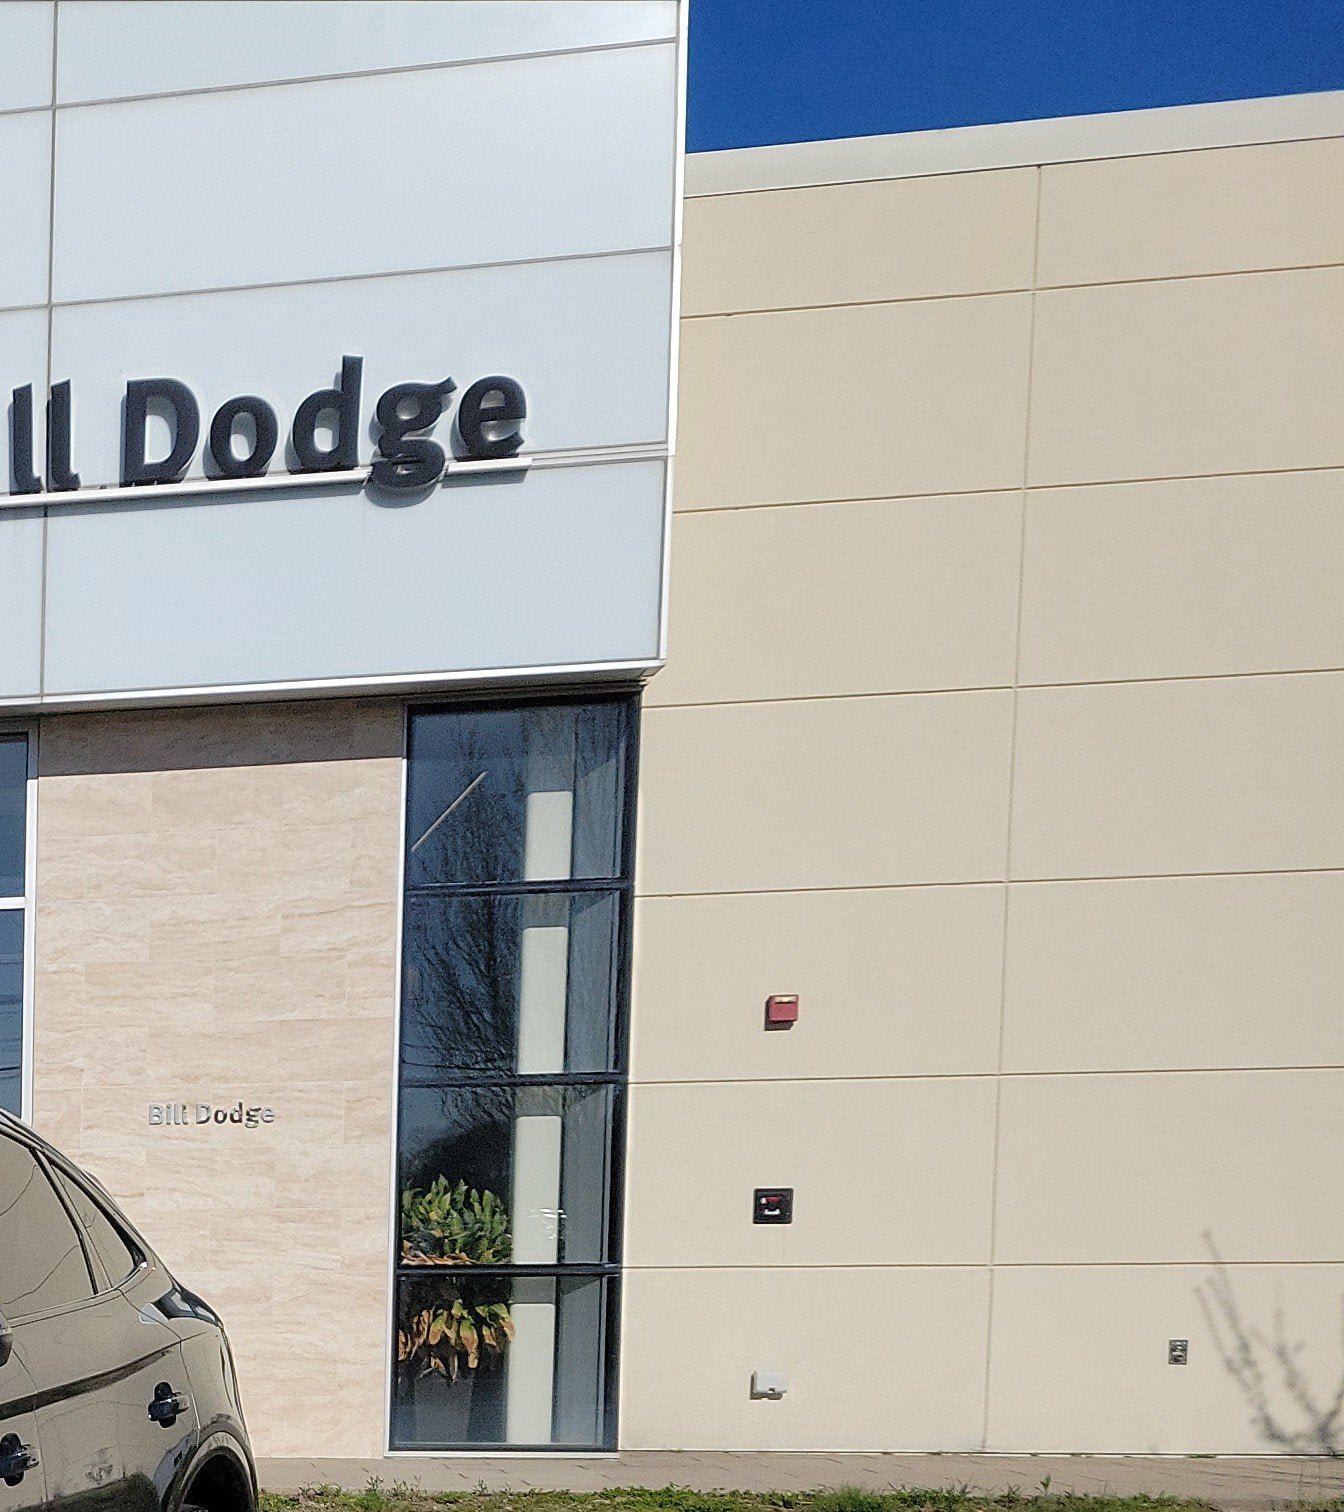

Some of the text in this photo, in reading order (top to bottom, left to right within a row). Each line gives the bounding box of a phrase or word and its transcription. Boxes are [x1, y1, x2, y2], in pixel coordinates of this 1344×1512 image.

[121, 355, 527, 506] Dodge
[148, 1101, 275, 1128] Bill Dodge
